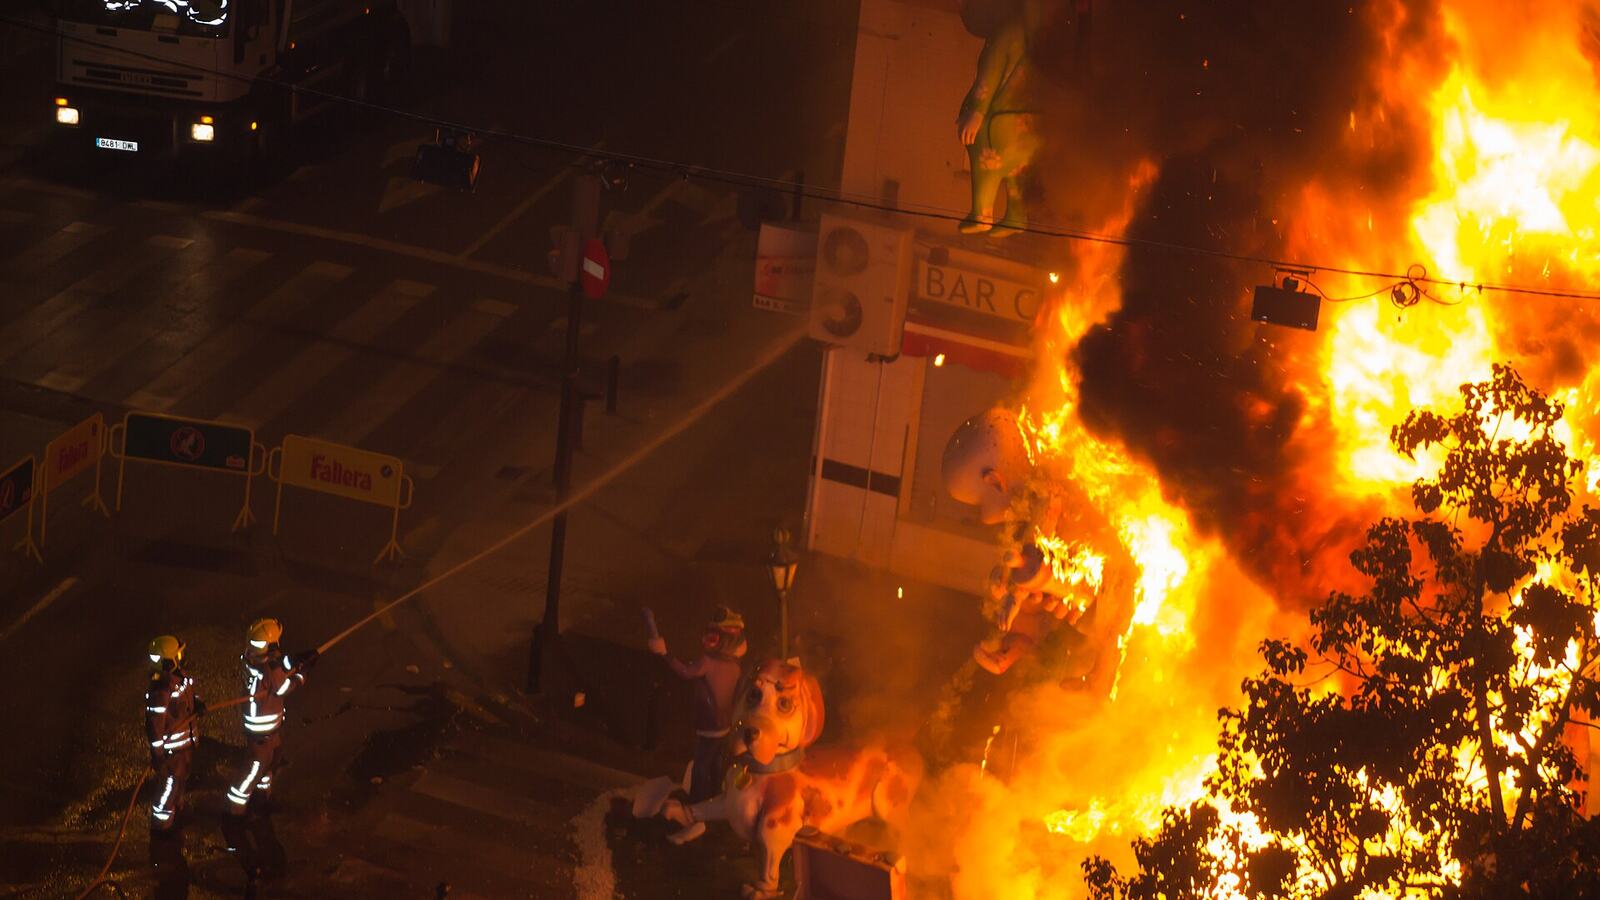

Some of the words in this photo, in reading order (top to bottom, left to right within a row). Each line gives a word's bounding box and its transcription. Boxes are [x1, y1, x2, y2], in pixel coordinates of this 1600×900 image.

[101, 139, 118, 148] 8481
[927, 267, 996, 312] BAR
[311, 453, 371, 490] Fallera
